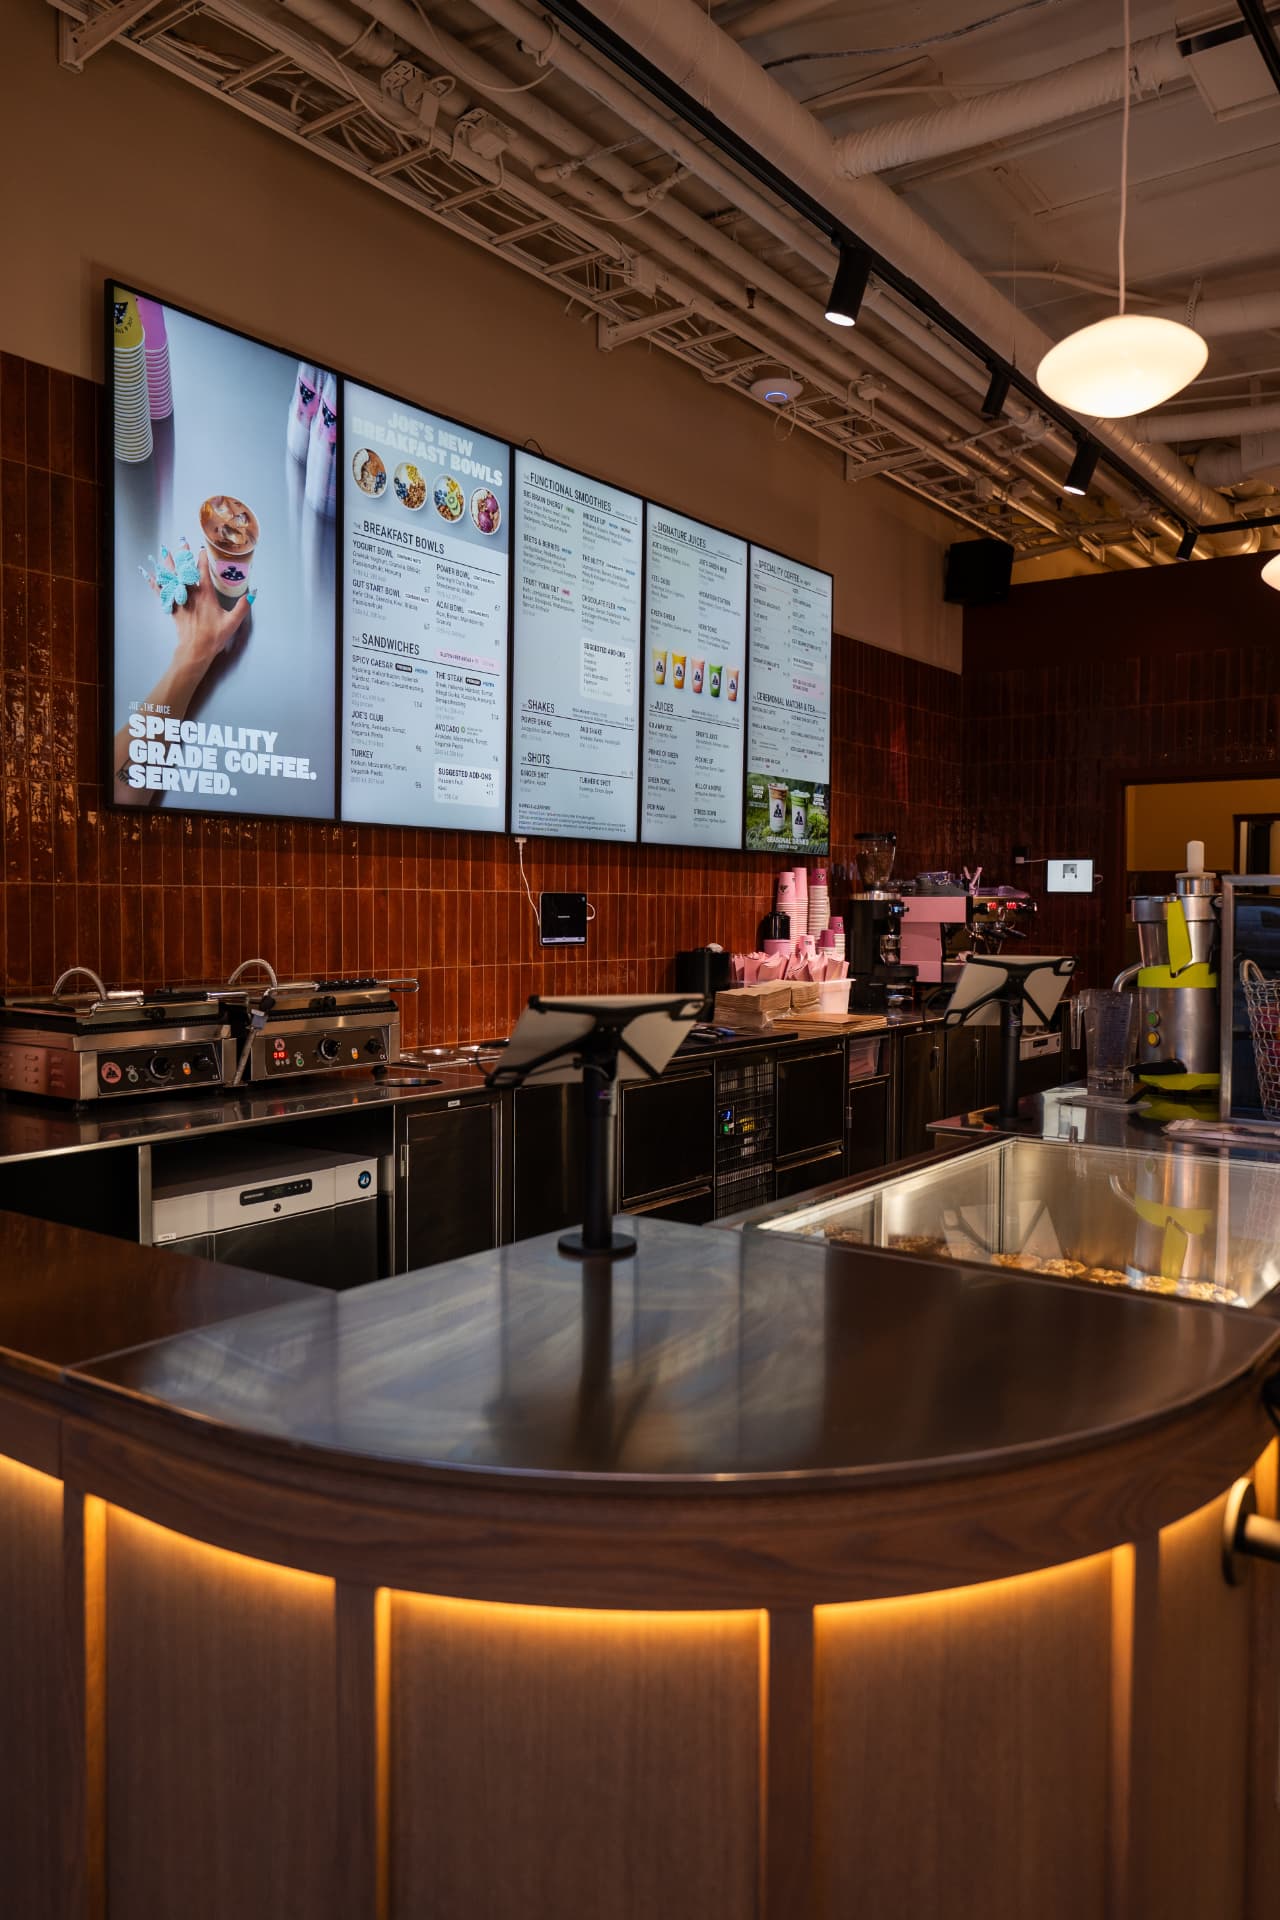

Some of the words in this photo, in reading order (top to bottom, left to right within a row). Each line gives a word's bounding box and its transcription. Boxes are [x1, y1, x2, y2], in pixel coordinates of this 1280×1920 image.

[387, 413, 434, 443] JOE'S
[438, 429, 473, 457] NEW
[352, 415, 447, 466] BREAKFAST
[451, 454, 503, 487] BOWLS
[530, 472, 573, 498] FUNCTIONAL
[575, 489, 611, 512] SMOOTHIES
[363, 520, 414, 546] BREAKFAST
[415, 536, 445, 555] BOWLS
[657, 521, 687, 542] SIGNATURE
[688, 533, 706, 549] JUICES
[352, 539, 376, 554] YOGURT
[377, 546, 393, 559] BOWL
[352, 578, 364, 589] GUT
[362, 632, 420, 656] SANDWICHES
[352, 654, 369, 665] SPICY
[370, 658, 393, 670] CAESAR
[436, 671, 445, 680] THE
[352, 710, 368, 720] JOE'S
[528, 698, 555, 714] SHAKES
[655, 700, 674, 713] JUICES
[128, 713, 278, 753] SPECIALITY
[128, 739, 218, 771] GRADE
[224, 749, 317, 781] COFFEE.
[351, 748, 374, 759] TURKEY
[527, 752, 551, 766] SHOTS
[128, 764, 238, 796] SERVED.
[438, 767, 468, 778] SUGGESTED
[469, 771, 492, 781] ADD-ONS
